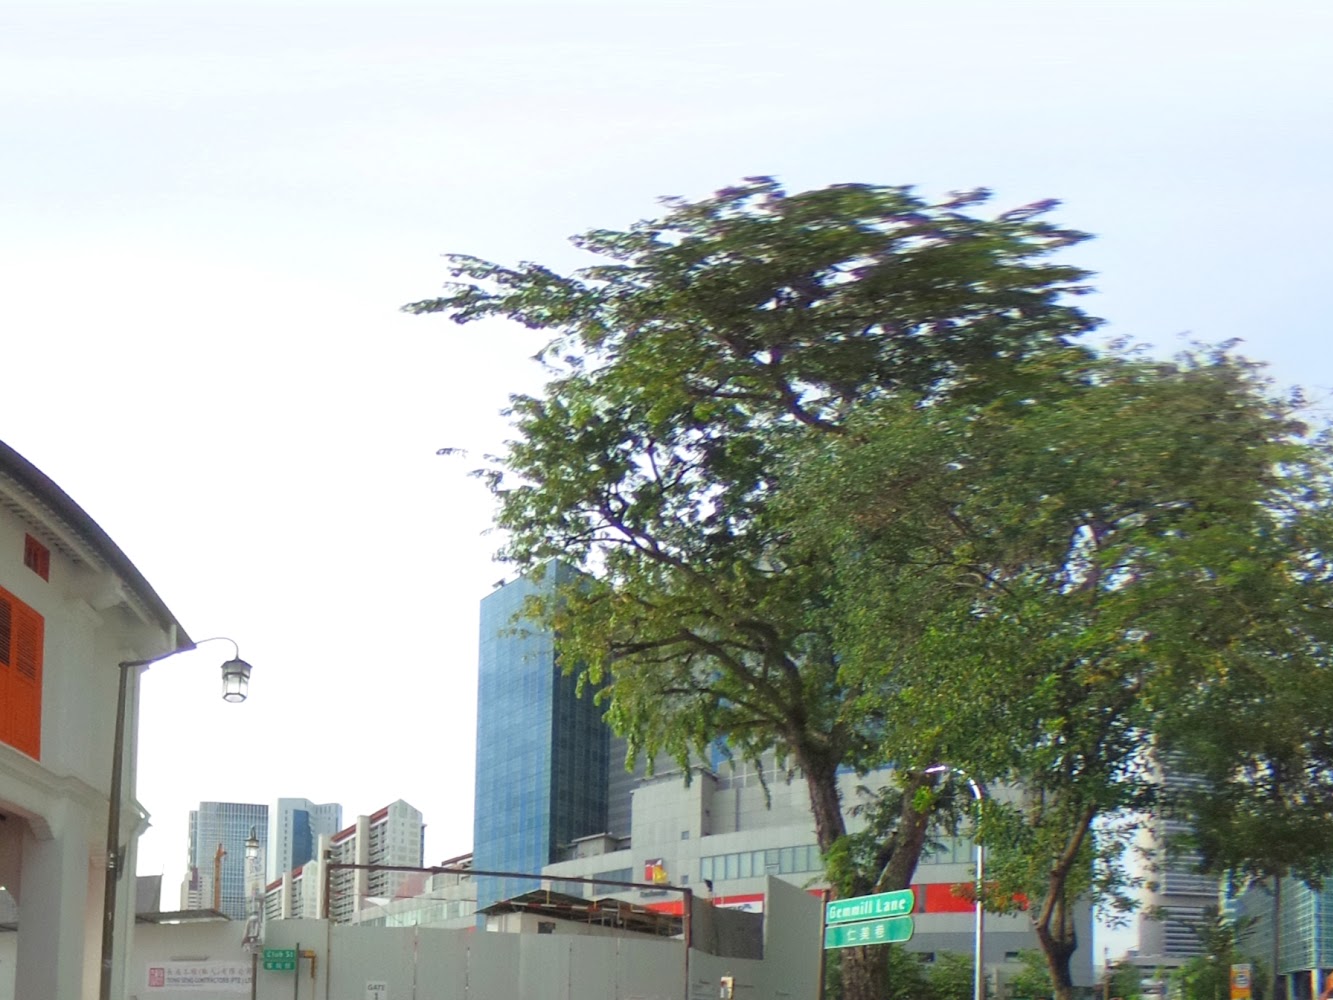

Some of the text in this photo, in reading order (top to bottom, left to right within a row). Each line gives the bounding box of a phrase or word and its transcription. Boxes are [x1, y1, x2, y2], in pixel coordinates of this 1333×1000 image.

[829, 898, 906, 919] Gemmill Lane
[266, 950, 294, 958] Club St
[367, 983, 386, 991] GATE
